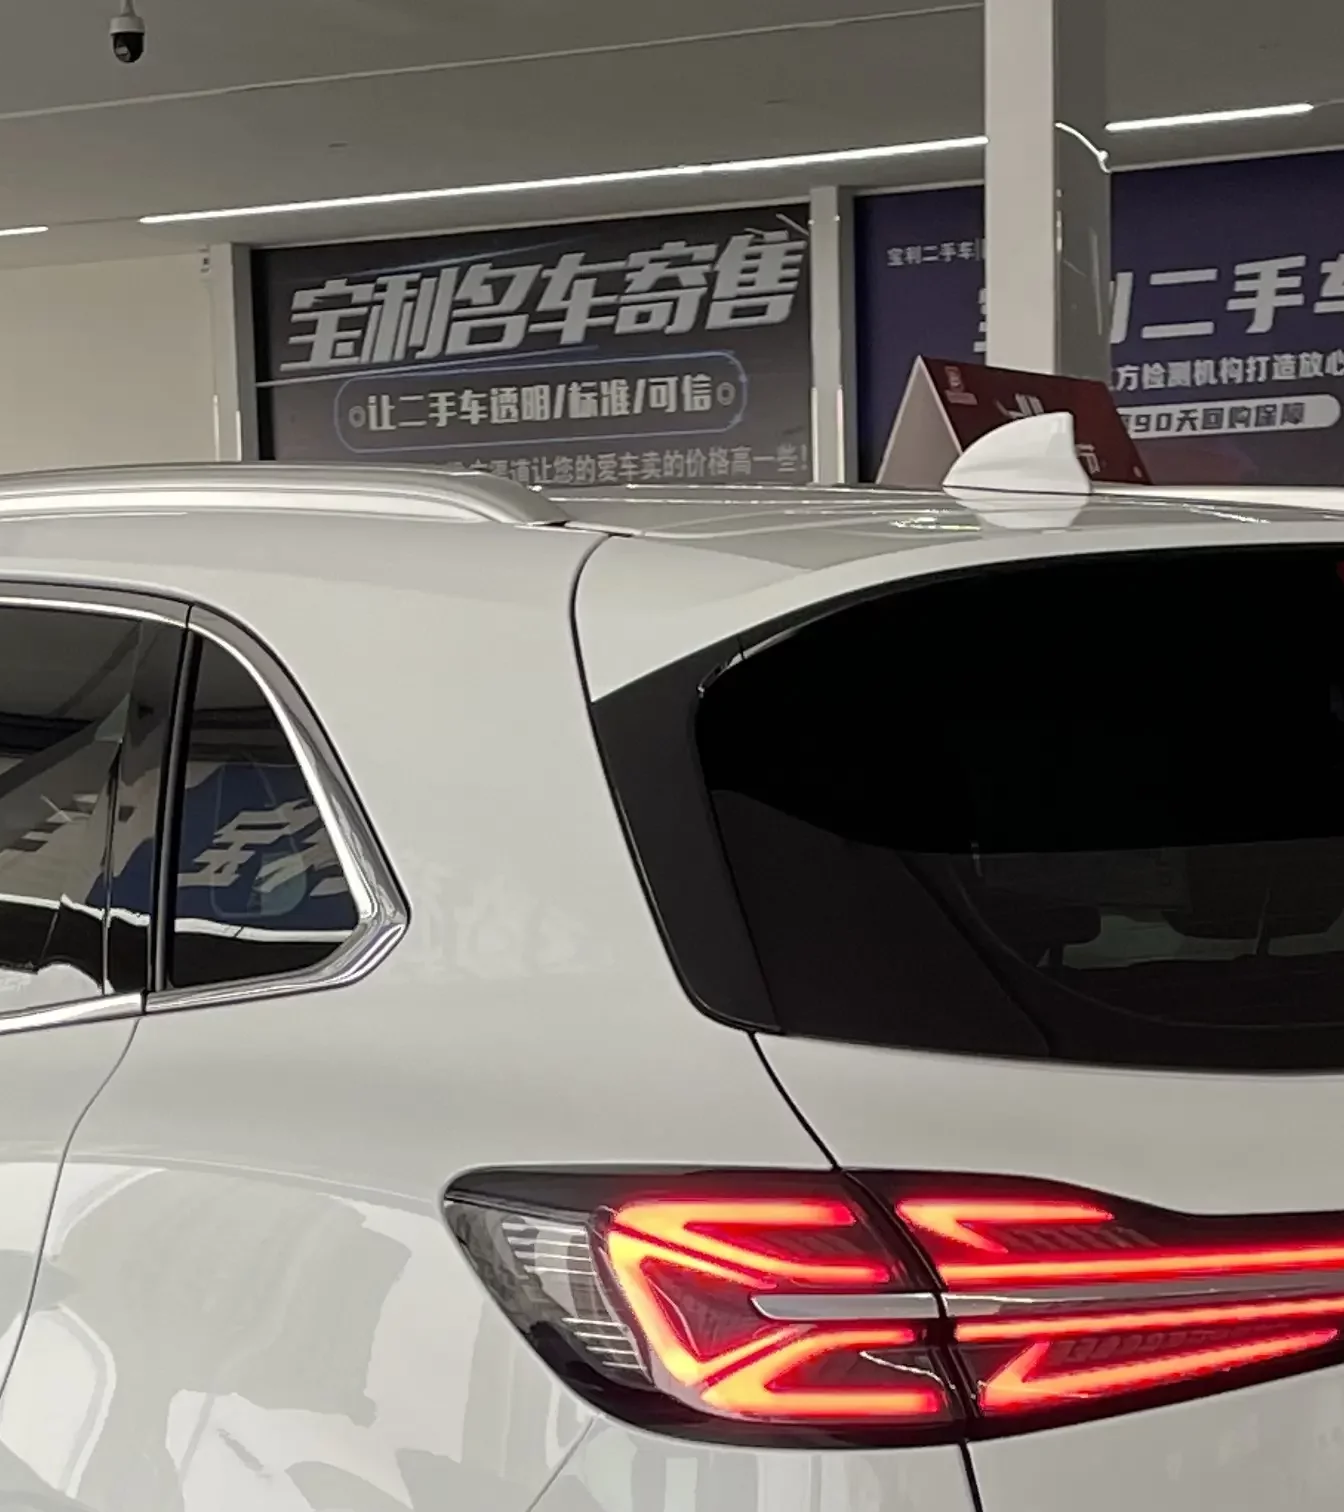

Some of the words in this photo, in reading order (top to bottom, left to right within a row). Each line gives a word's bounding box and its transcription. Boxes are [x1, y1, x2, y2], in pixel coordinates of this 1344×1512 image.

[887, 241, 975, 267] 宝利二手车
[280, 229, 808, 372] 宝利名车寄售
[366, 373, 713, 431] 让二手车透明/标准/可信
